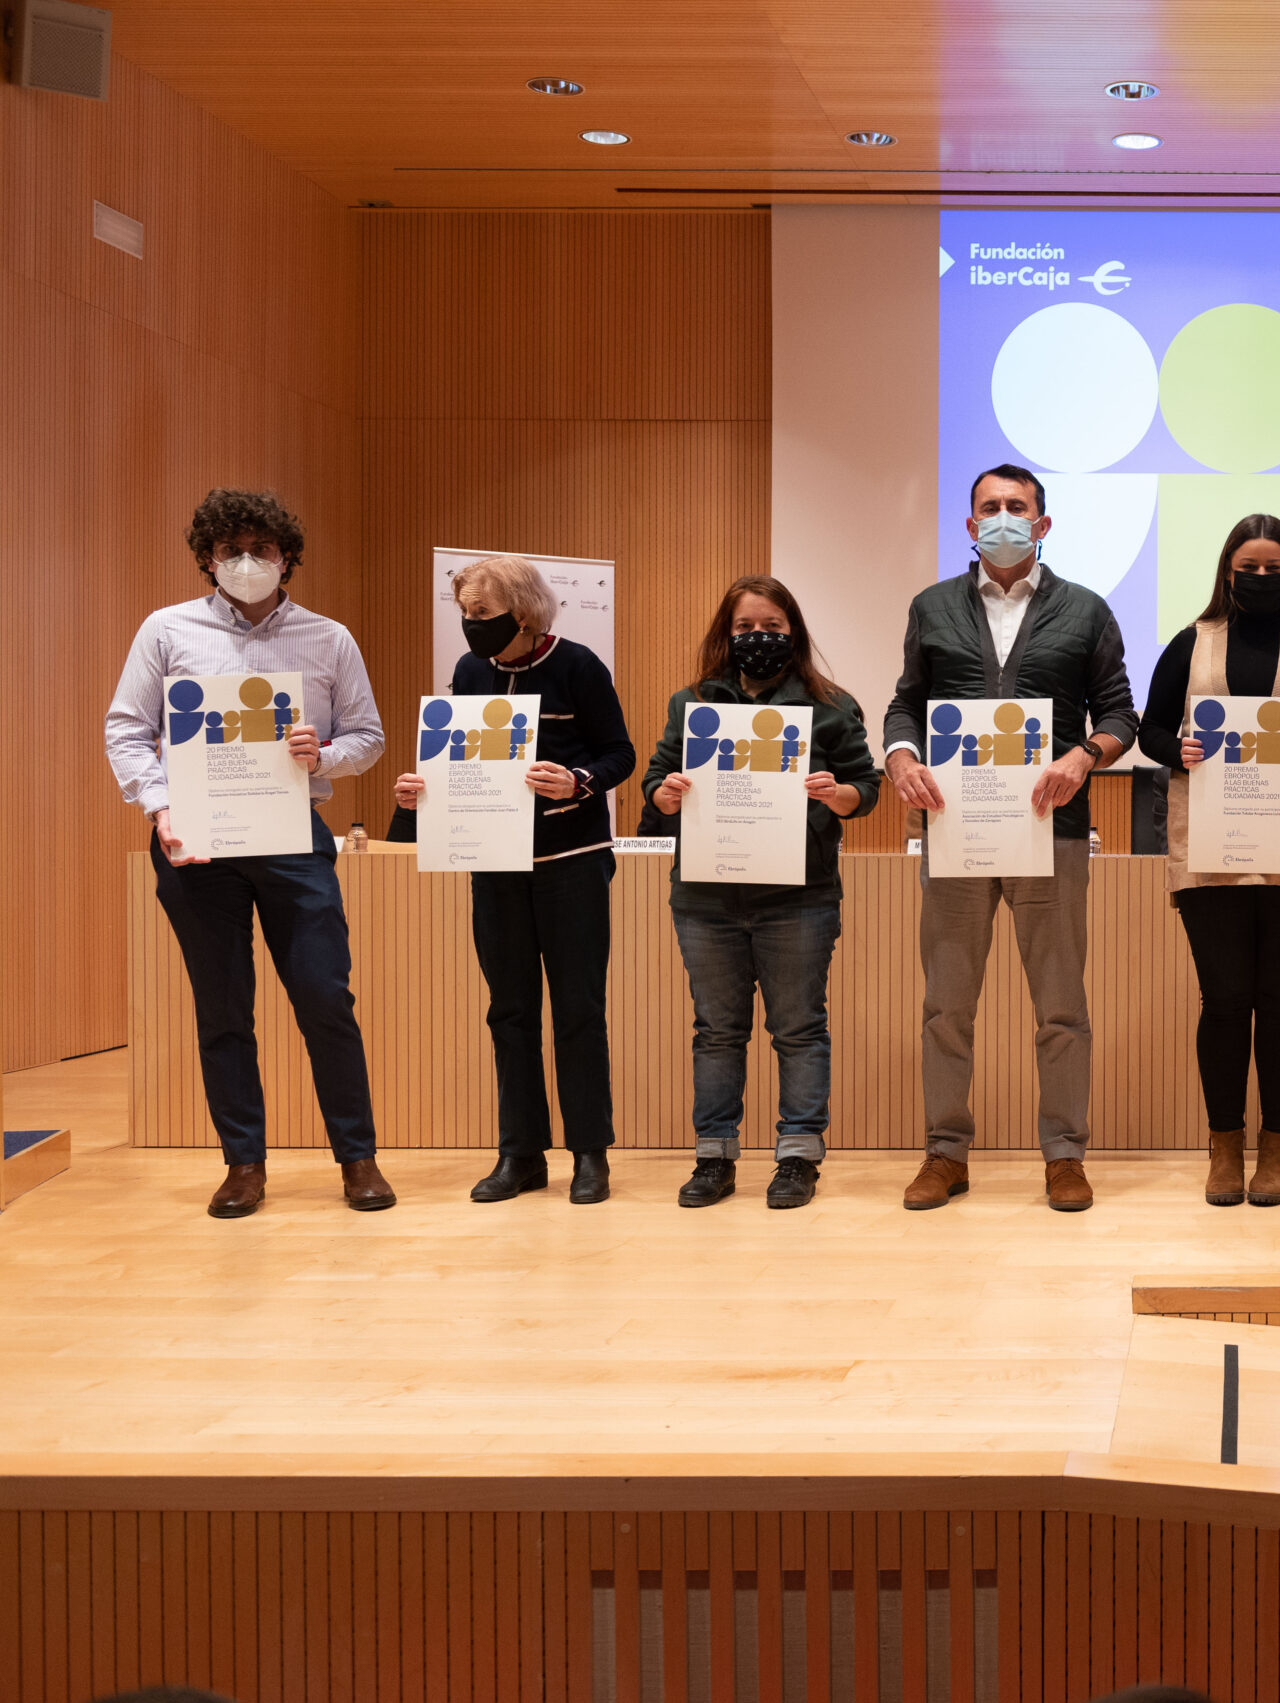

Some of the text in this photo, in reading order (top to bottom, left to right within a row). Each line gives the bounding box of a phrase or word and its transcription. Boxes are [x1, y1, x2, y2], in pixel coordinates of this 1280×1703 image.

[970, 242, 1065, 260] Fundación
[970, 265, 1070, 290] iberCaja
[207, 765, 247, 774] PRÁCTICAS
[613, 838, 621, 848] SÉ
